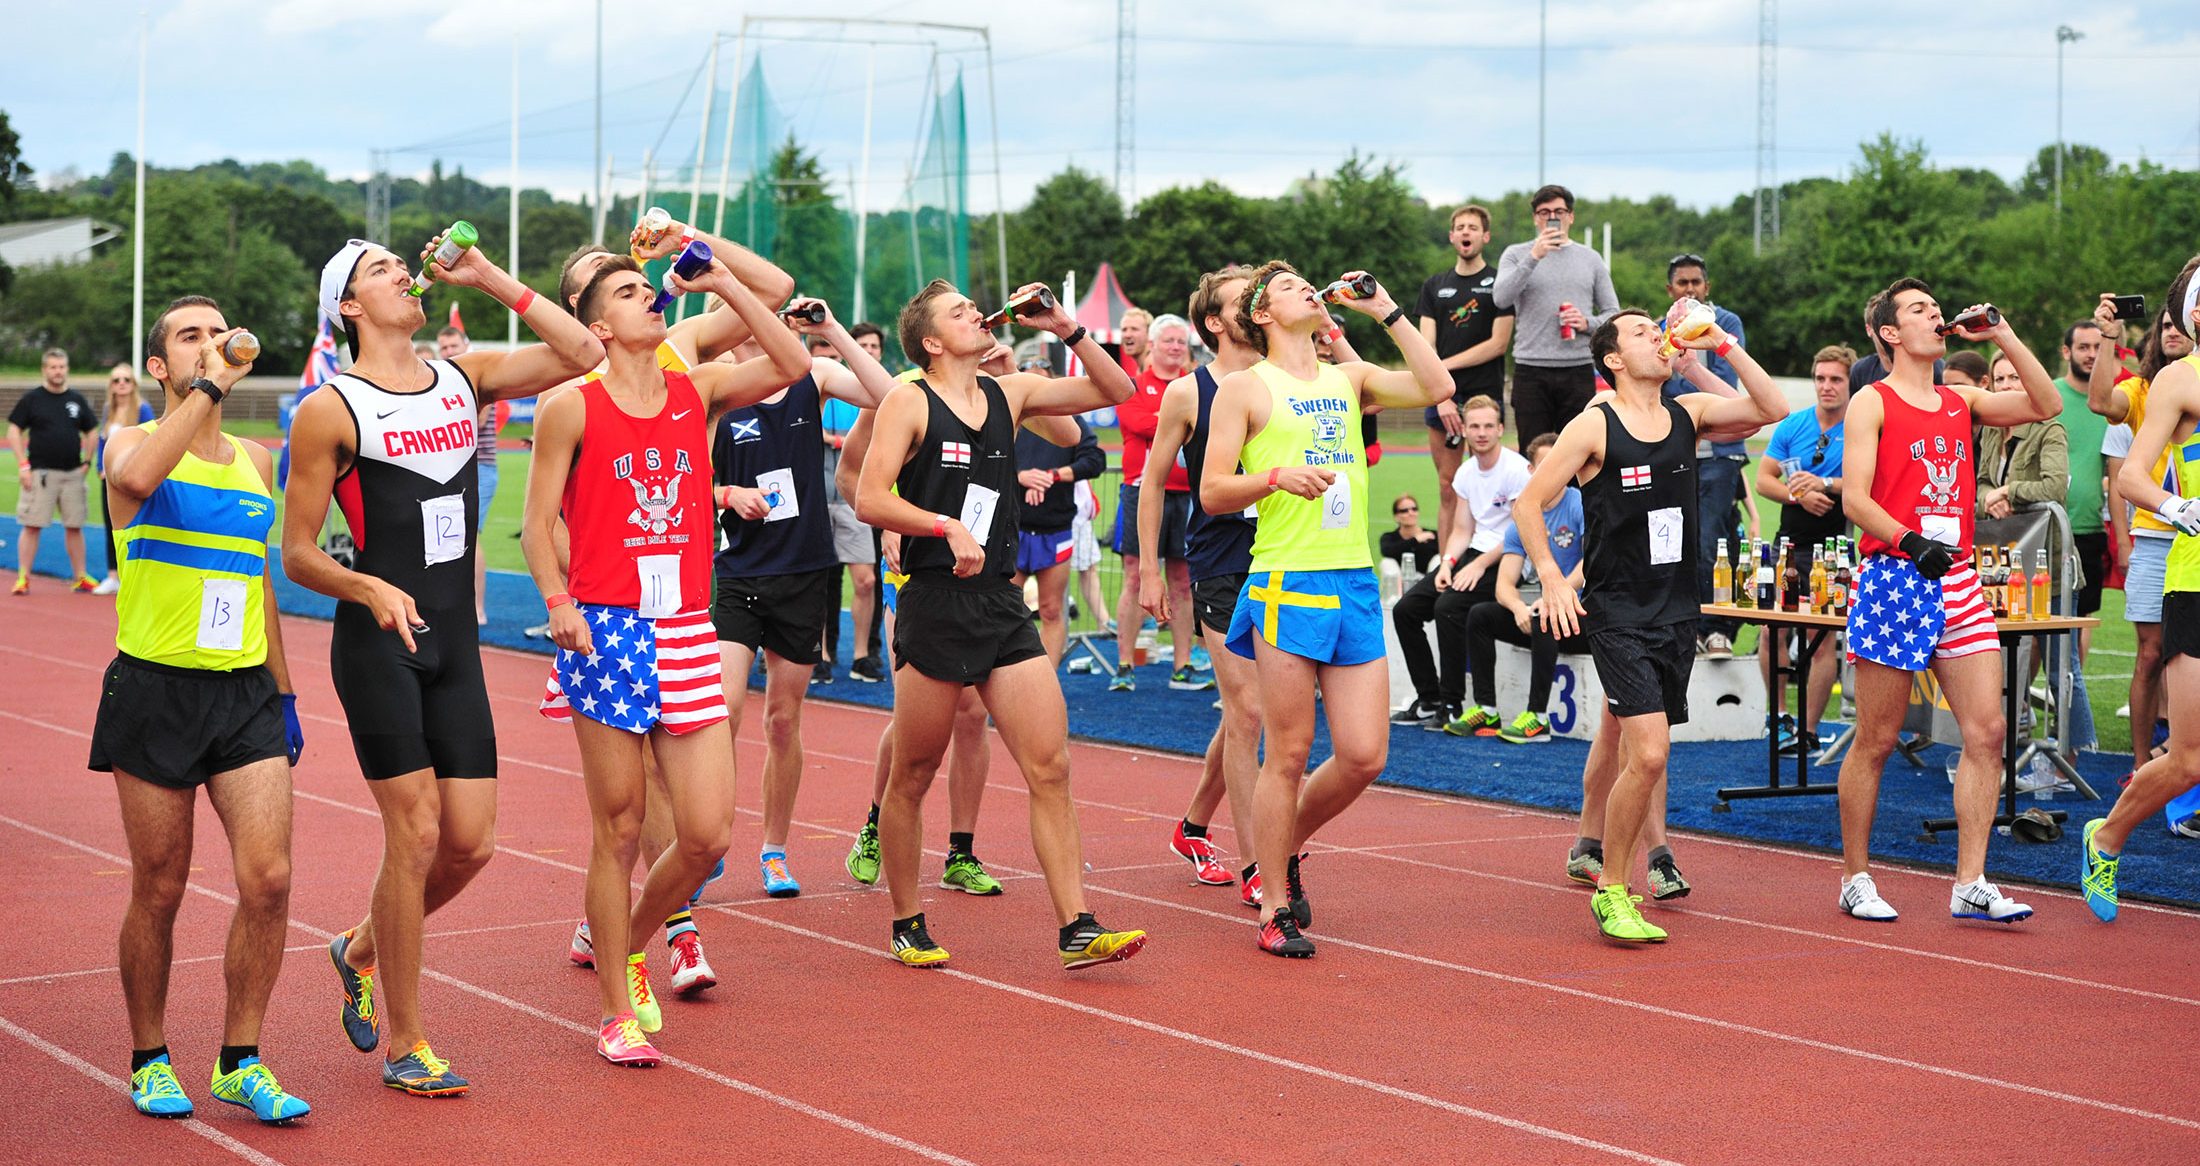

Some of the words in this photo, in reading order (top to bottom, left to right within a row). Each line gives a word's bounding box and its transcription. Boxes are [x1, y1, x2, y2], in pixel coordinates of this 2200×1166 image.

[1292, 398, 1348, 416] SWEDEN
[383, 420, 474, 457] CANADA
[1306, 453, 1330, 465] Beer
[1333, 450, 1354, 464] Mile
[970, 502, 982, 533] 9
[1332, 494, 1345, 516] 6
[436, 515, 459, 545] 12
[624, 537, 646, 547] BEER
[648, 535, 667, 545] MILE
[669, 534, 689, 543] TEAM
[1658, 524, 1669, 547] 4
[652, 575, 662, 608] 11
[212, 597, 231, 628] 13
[1549, 663, 1577, 734] 3
